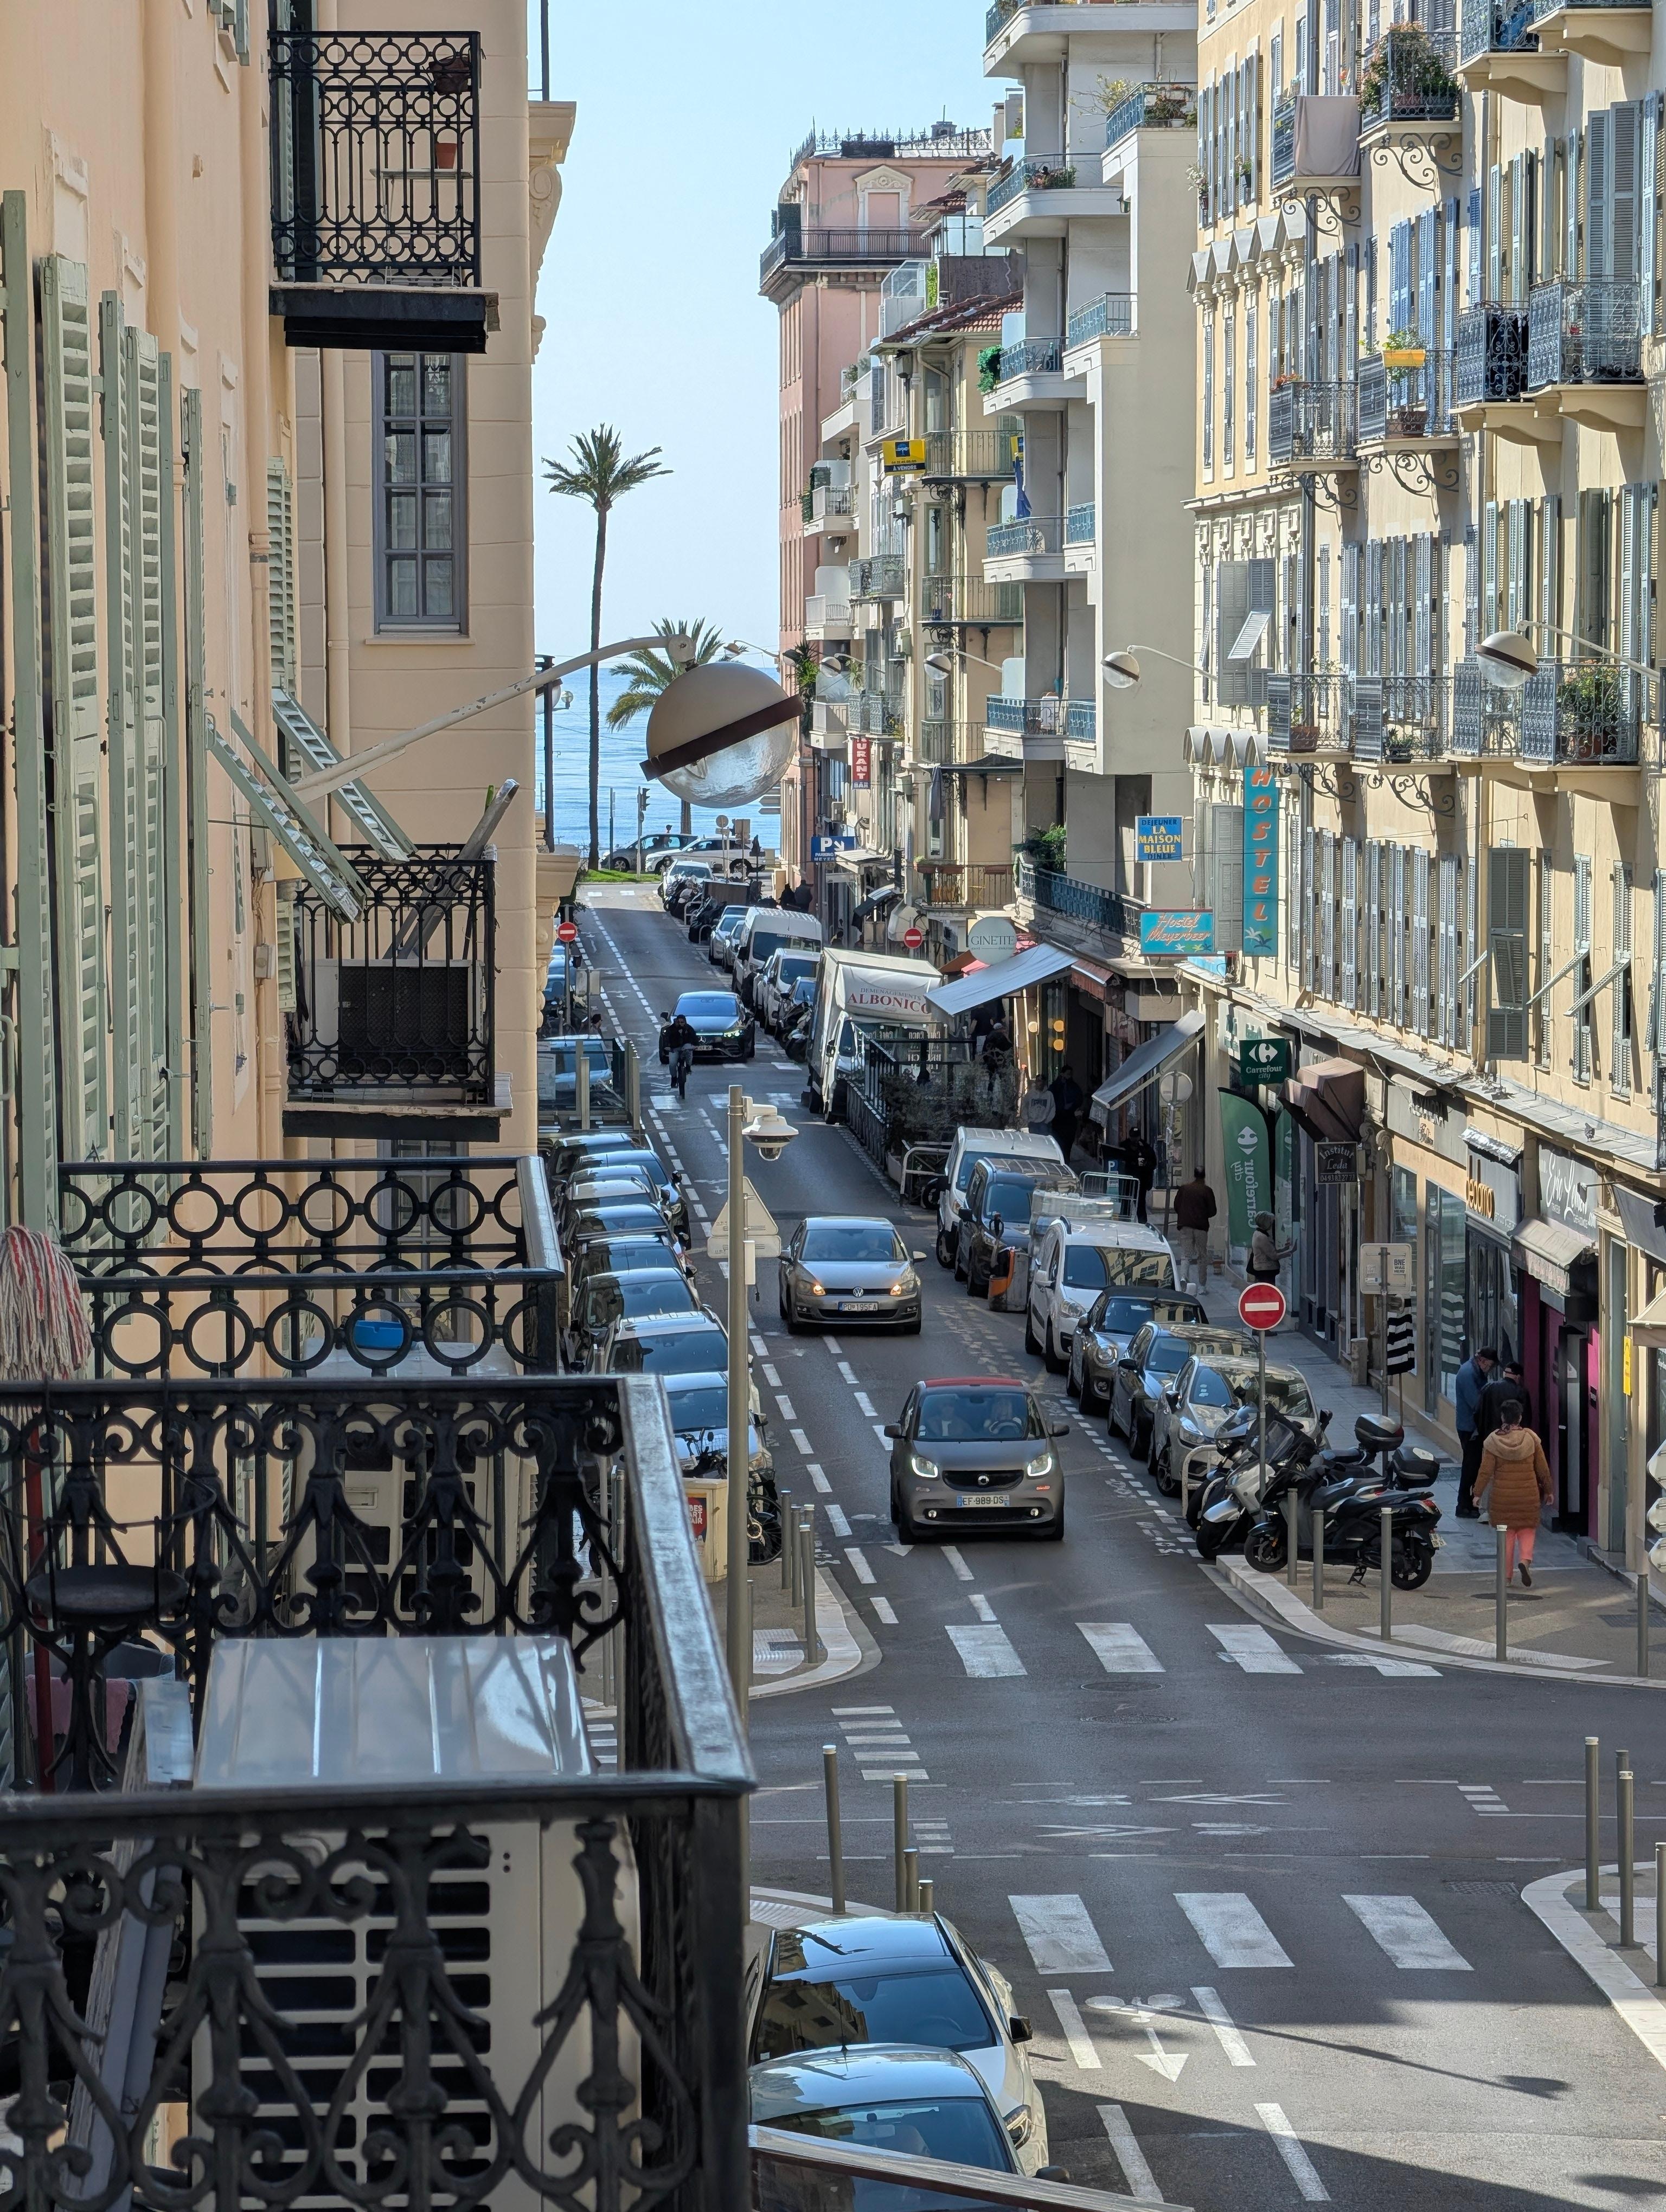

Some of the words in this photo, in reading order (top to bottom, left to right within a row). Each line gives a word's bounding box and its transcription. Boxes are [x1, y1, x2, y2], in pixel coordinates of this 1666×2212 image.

[1152, 826, 1167, 834] LA
[821, 837, 832, 852] P
[1139, 835, 1181, 844] MAISON
[1144, 844, 1176, 854] BLEUE
[1251, 768, 1273, 922] HOSTEL
[1157, 913, 1201, 928] Hostel
[971, 935, 1015, 946] GINETTE
[1246, 1065, 1283, 1074] Carrefour
[1258, 1072, 1271, 1081] city
[1319, 1145, 1354, 1160] Institut
[962, 1496, 1004, 1506] EF-989-DS
